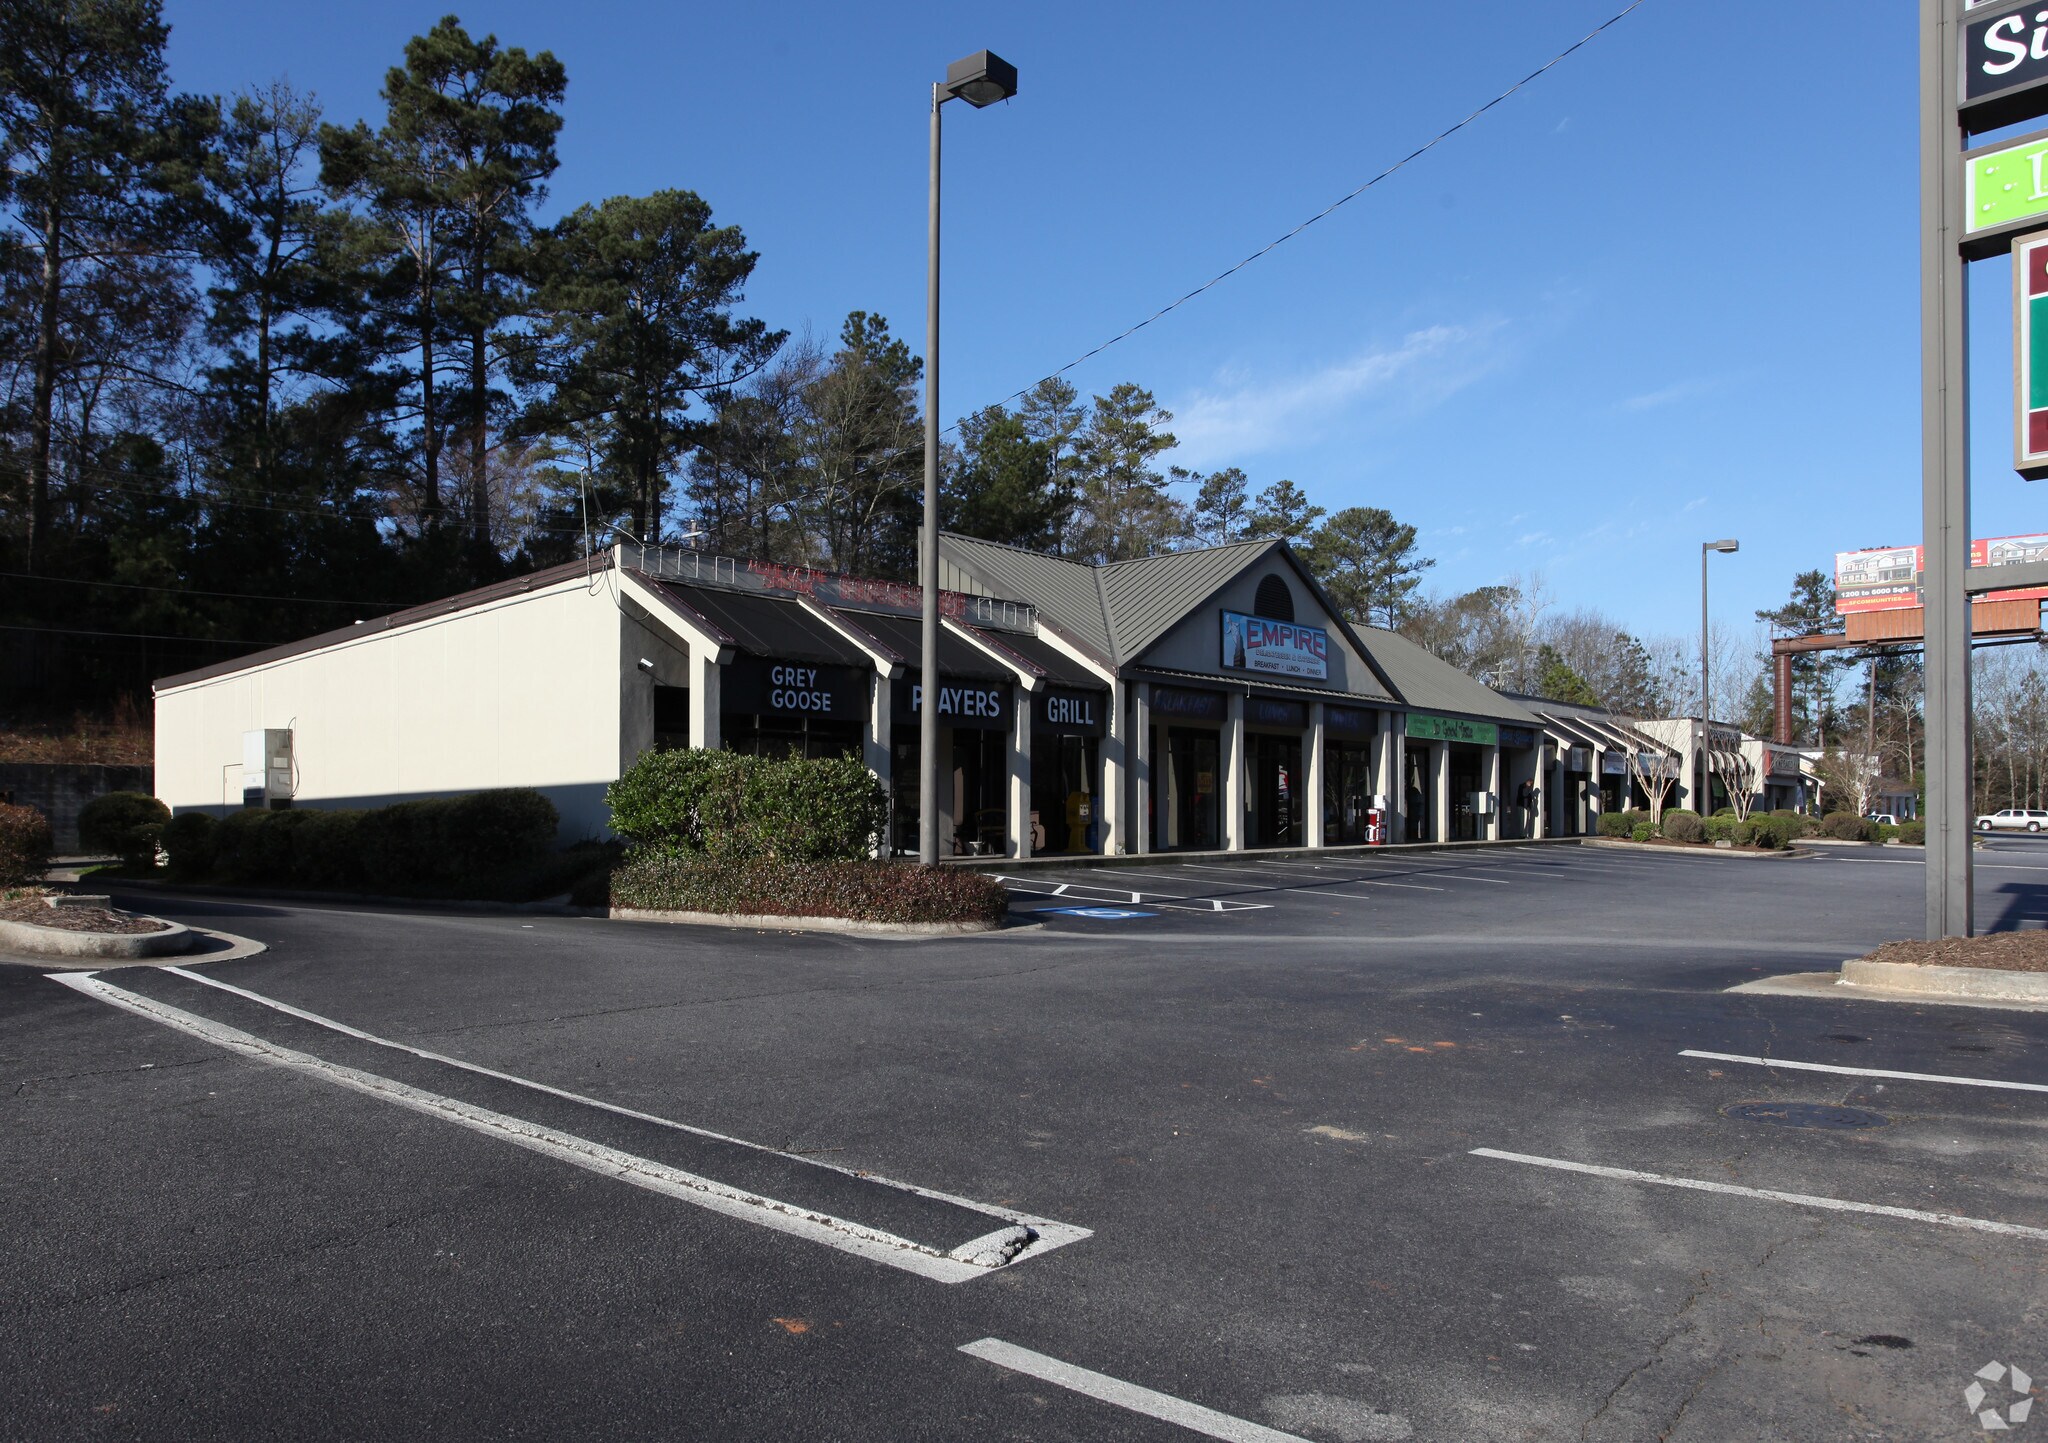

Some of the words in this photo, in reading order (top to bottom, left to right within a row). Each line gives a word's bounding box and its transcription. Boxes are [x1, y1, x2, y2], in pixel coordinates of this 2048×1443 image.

[1841, 590, 1859, 598] 1200
[1871, 588, 1891, 596] 6000
[1892, 586, 1909, 594] Sqft
[1247, 619, 1327, 661] EMPIRE
[772, 665, 816, 688] GREY
[1254, 660, 1279, 670] BREAKFAST
[772, 689, 831, 712] GOOSE
[912, 685, 1000, 718] PAYERS
[1048, 697, 1094, 725] GRILL
